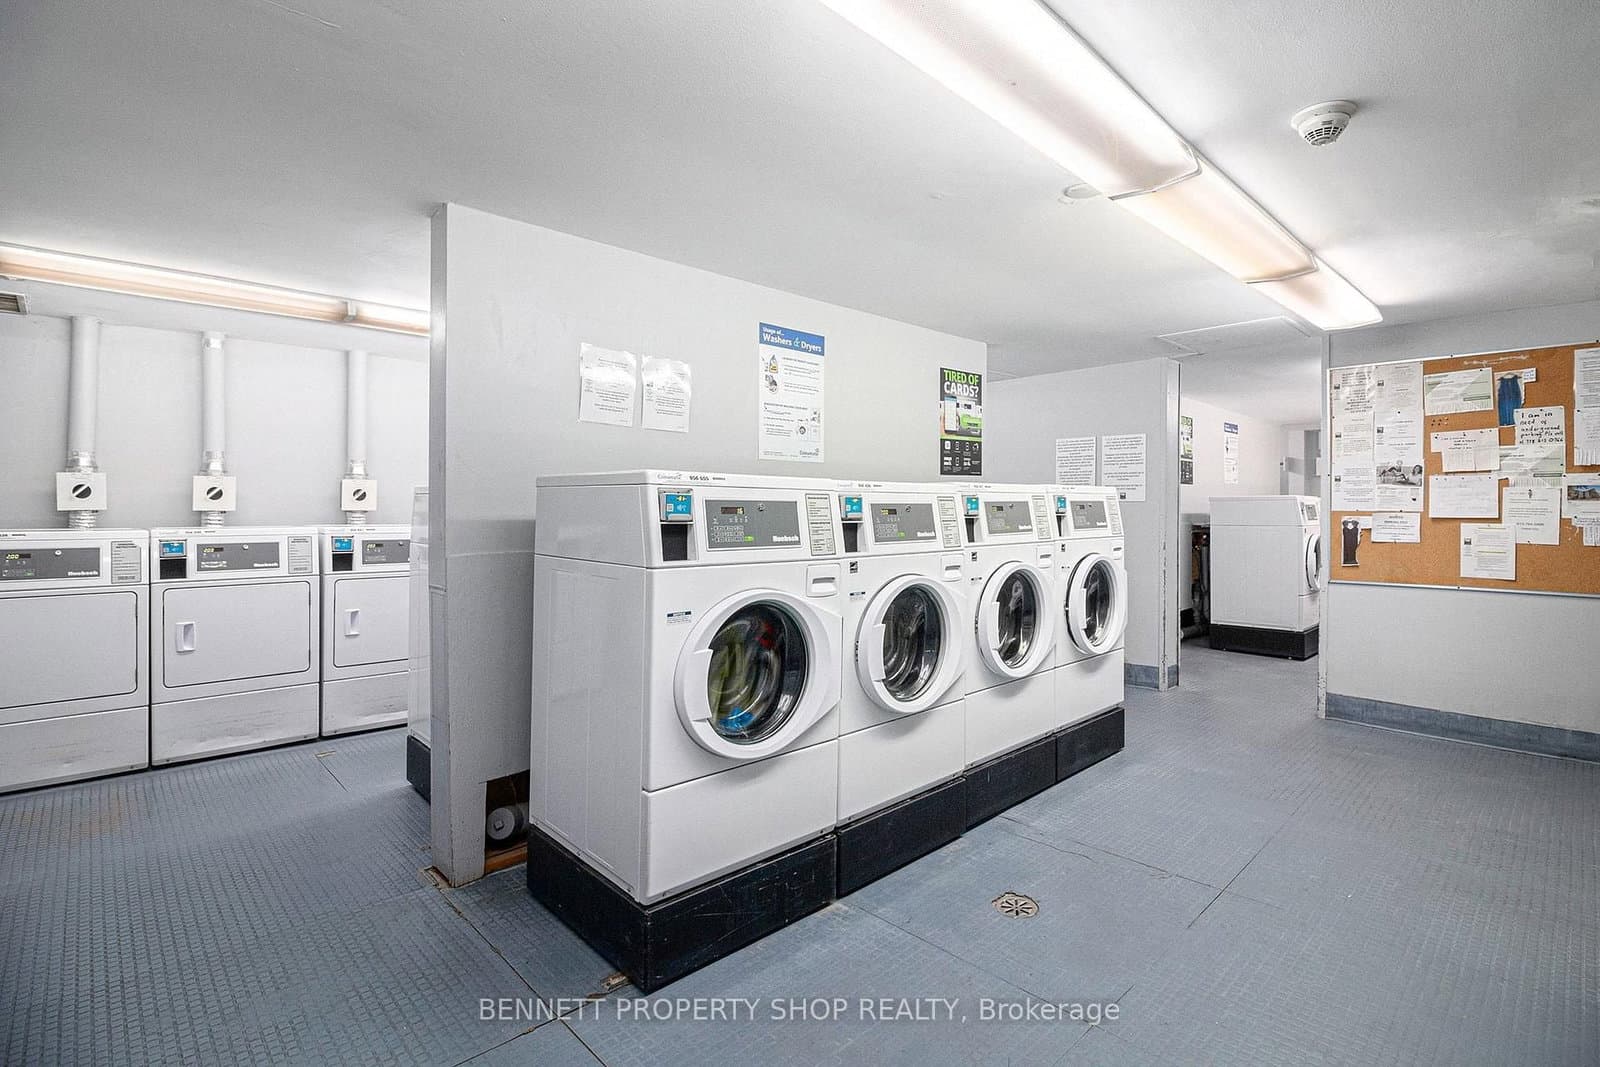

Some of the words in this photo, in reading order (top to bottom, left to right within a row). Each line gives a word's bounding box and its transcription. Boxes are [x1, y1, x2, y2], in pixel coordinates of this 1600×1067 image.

[762, 332, 793, 346] Washers
[793, 336, 800, 348] &
[801, 341, 822, 352] Dryers
[943, 369, 967, 383] TIRED
[968, 375, 979, 386] OF
[944, 381, 979, 398] CARDS?
[1520, 418, 1536, 426] need
[1521, 425, 1560, 433] underground
